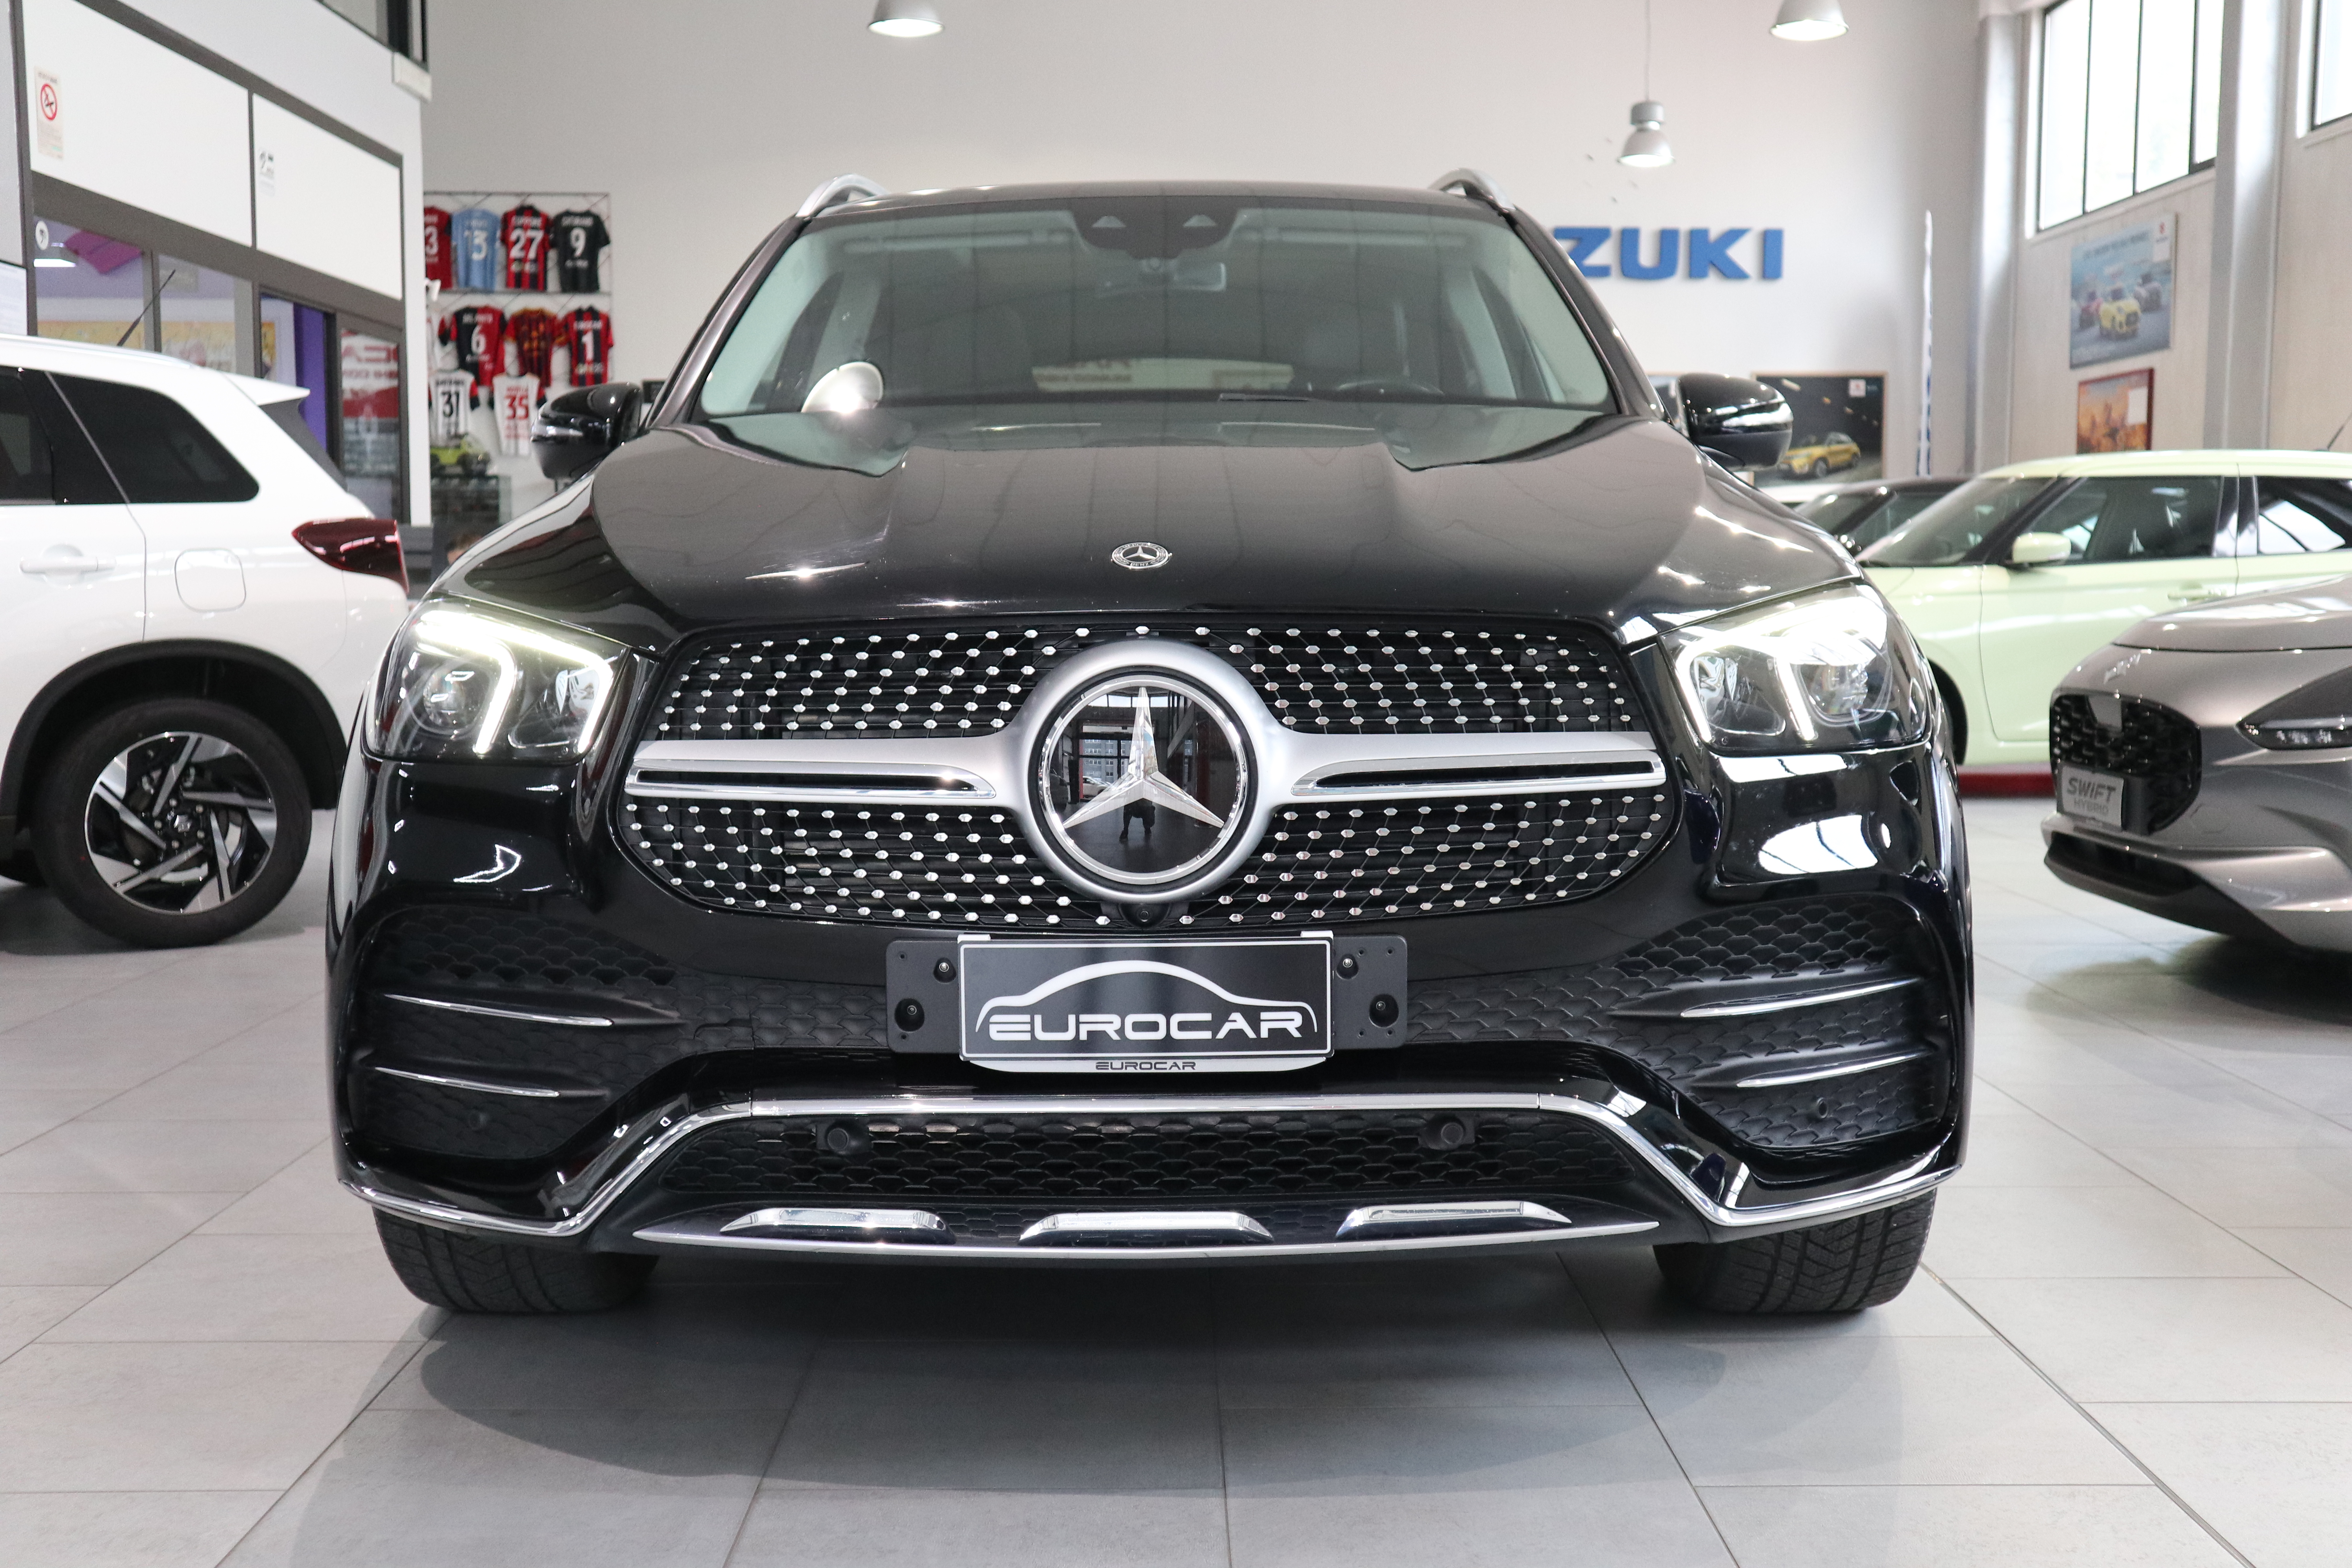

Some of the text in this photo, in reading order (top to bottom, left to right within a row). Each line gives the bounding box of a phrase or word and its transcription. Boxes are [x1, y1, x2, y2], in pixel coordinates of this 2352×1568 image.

[464, 230, 488, 260] 13
[509, 228, 544, 260] 27
[570, 227, 586, 257] 9
[1554, 228, 1783, 280] ZUKI
[471, 325, 486, 354] 6
[582, 331, 593, 361] 1
[441, 390, 460, 417] 31
[504, 395, 528, 419] 35
[2067, 777, 2116, 803] SWIFT
[2074, 797, 2109, 815] HYBRID
[989, 1011, 1302, 1041] EUROCAR
[1095, 1061, 1196, 1071] EUROCAR
